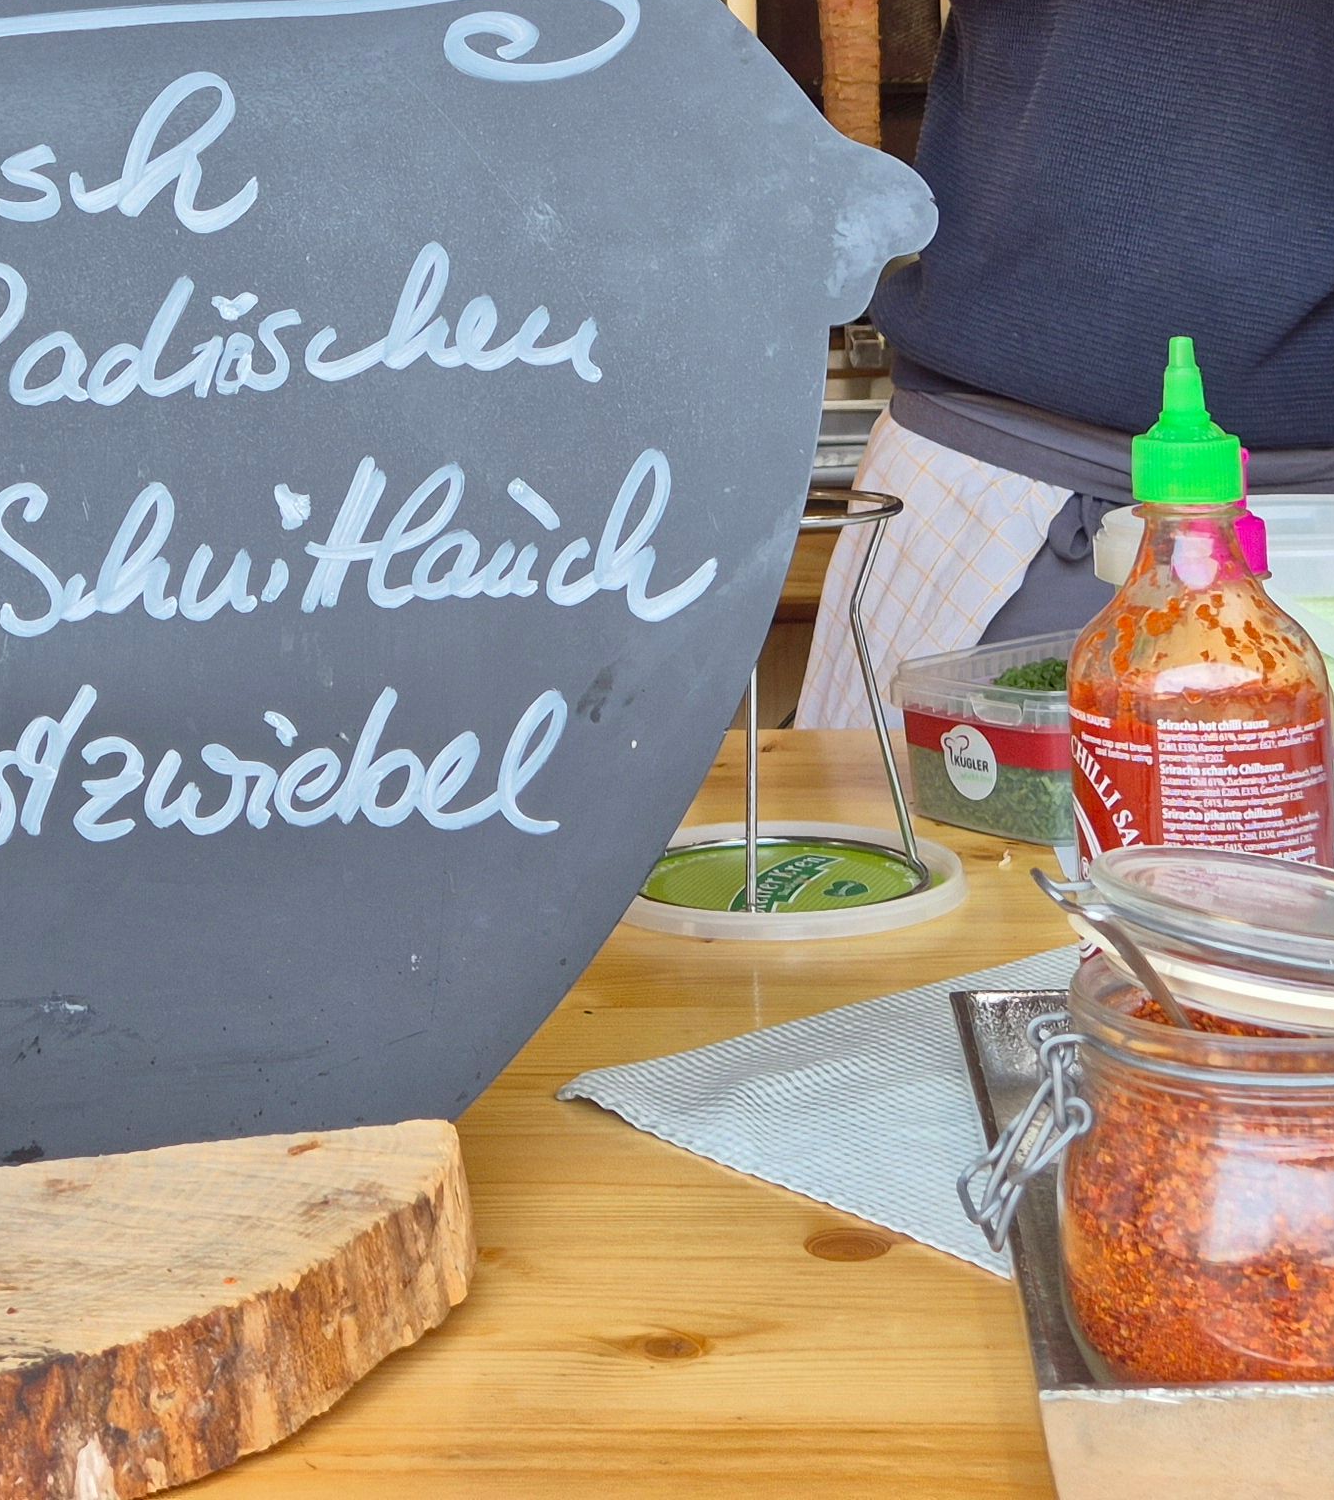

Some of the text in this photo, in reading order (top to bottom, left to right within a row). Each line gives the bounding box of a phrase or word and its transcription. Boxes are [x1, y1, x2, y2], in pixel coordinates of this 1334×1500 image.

[1156, 718, 1198, 731] Sriracha
[1198, 720, 1217, 731] hot
[1242, 719, 1269, 730] sauce
[954, 754, 989, 773] KUGLER
[1159, 763, 1200, 776] Sriracha
[1069, 734, 1123, 811] CHILLI
[1162, 807, 1203, 820] Sriracha
[767, 856, 827, 880] Kren
